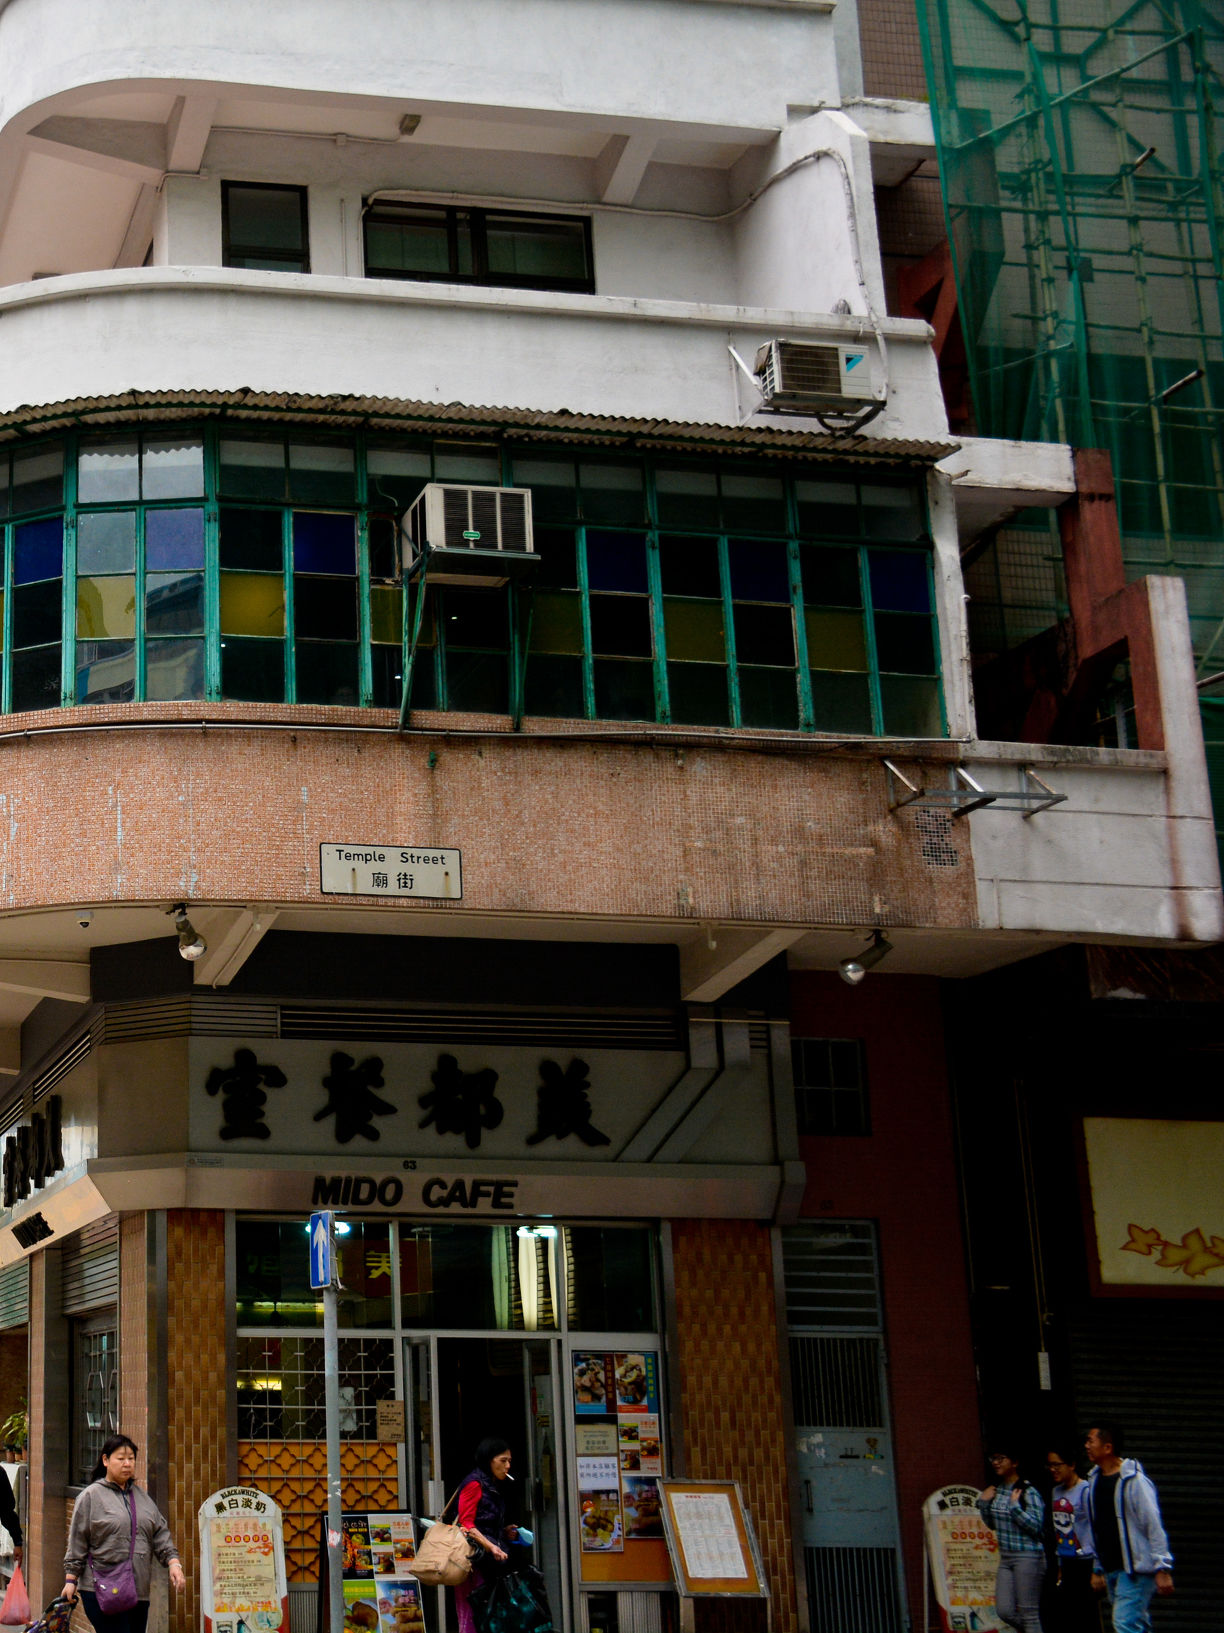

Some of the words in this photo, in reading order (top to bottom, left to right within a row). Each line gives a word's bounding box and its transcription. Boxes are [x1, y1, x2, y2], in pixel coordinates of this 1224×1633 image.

[335, 849, 386, 864] Temple
[400, 851, 446, 866] Street
[371, 871, 414, 889] 廟街
[403, 1160, 417, 1170] 63
[312, 1175, 403, 1207] MIDO
[422, 1178, 518, 1209] CAFE
[214, 1497, 267, 1515] 黑白淡奶
[937, 1496, 980, 1511] 黑白淡
